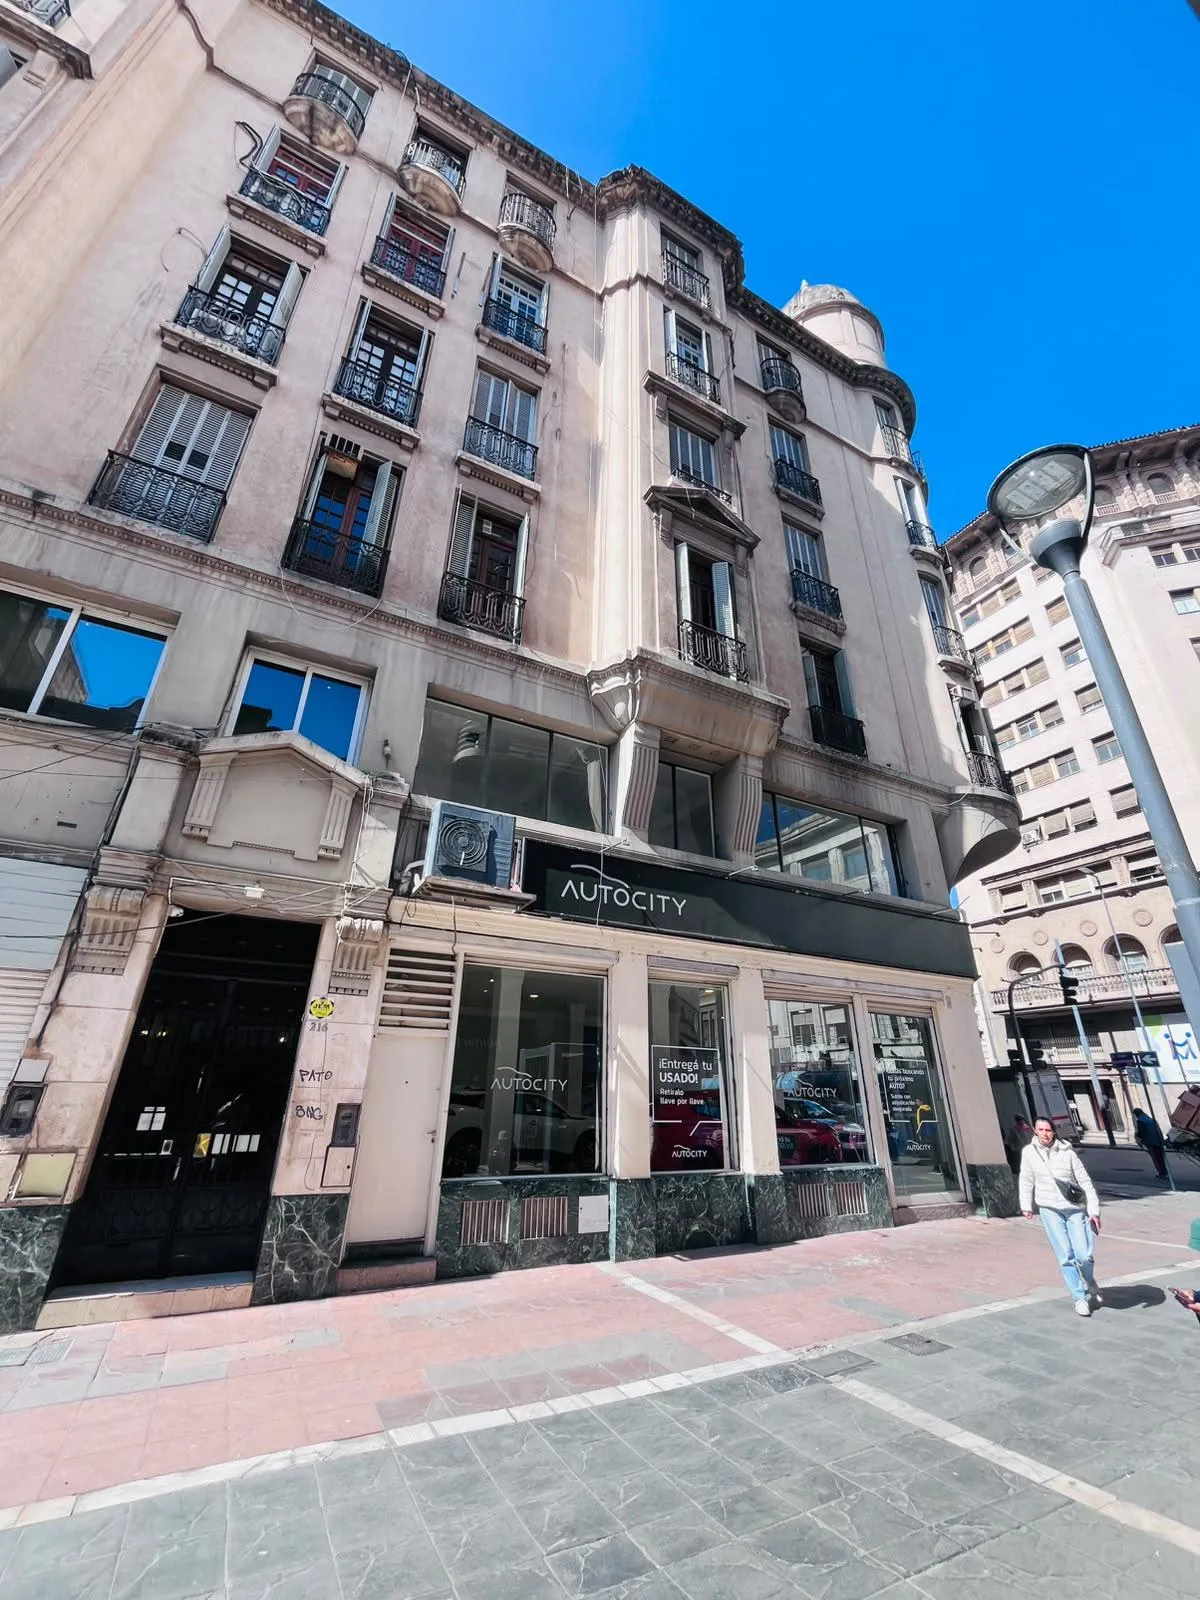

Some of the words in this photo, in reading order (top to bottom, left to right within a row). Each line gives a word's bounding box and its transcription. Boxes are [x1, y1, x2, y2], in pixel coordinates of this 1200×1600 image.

[560, 879, 687, 916] AUTOCITY
[702, 1061, 713, 1071] tu
[299, 1069, 333, 1082] PATO
[659, 1072, 699, 1084] USADO!
[490, 1077, 568, 1091] AUTOCITY
[787, 1086, 837, 1098] AUTOCITY
[660, 1097, 676, 1105] llave
[677, 1099, 688, 1107] por
[689, 1097, 705, 1105] llave
[671, 1150, 708, 1158] AUTOCITY
